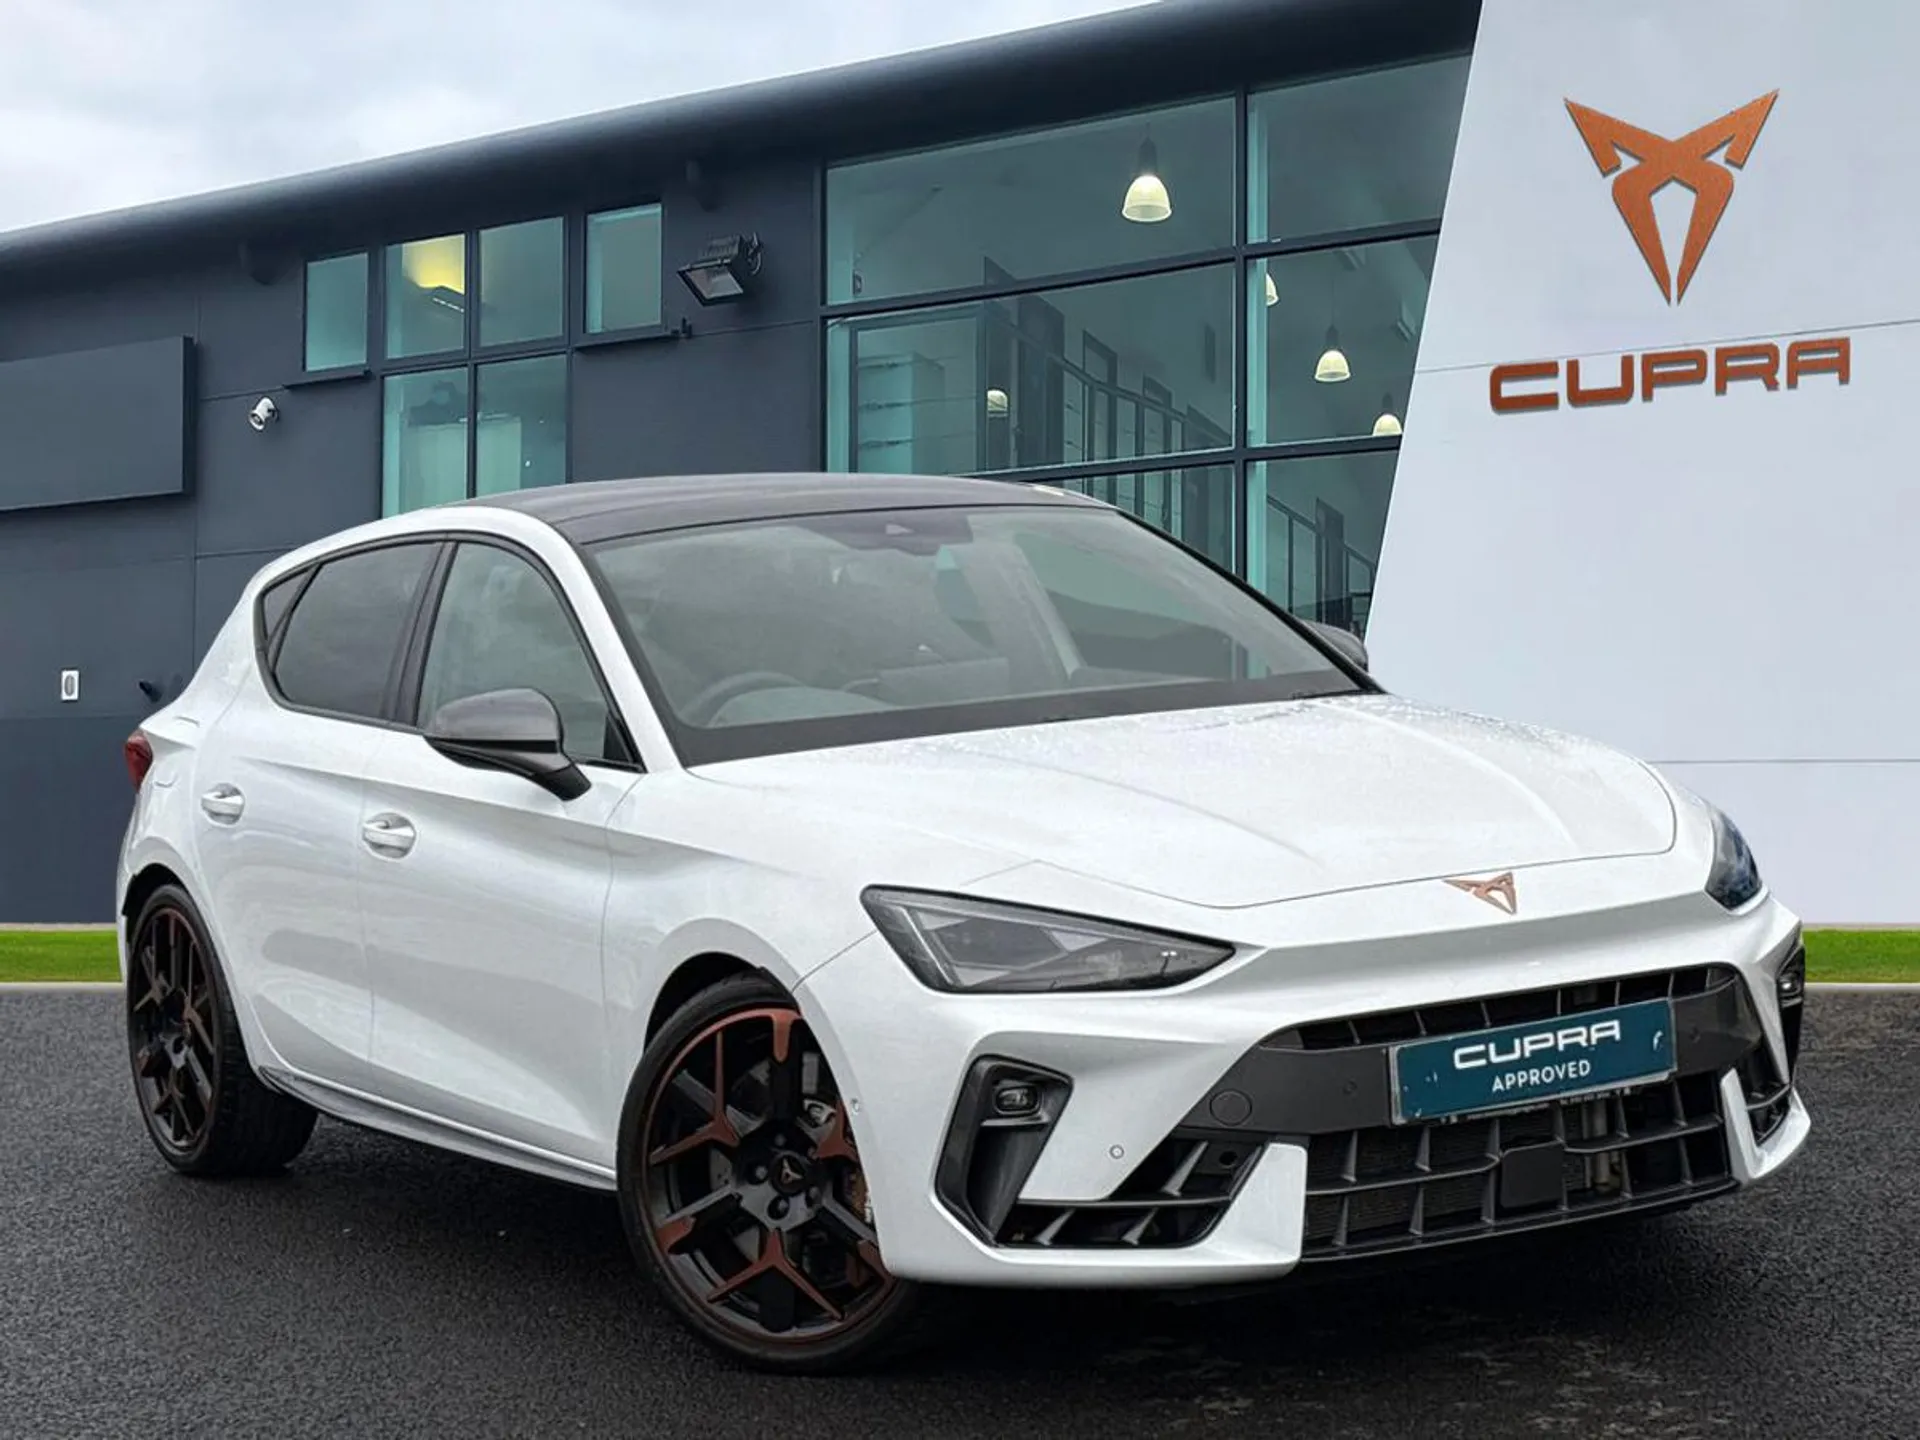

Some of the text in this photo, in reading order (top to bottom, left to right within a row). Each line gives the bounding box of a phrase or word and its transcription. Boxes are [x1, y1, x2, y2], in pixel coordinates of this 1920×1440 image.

[1490, 337, 1850, 415] CUPRA
[1453, 1020, 1621, 1069] CUPRA
[1492, 1060, 1591, 1092] APPROVED
